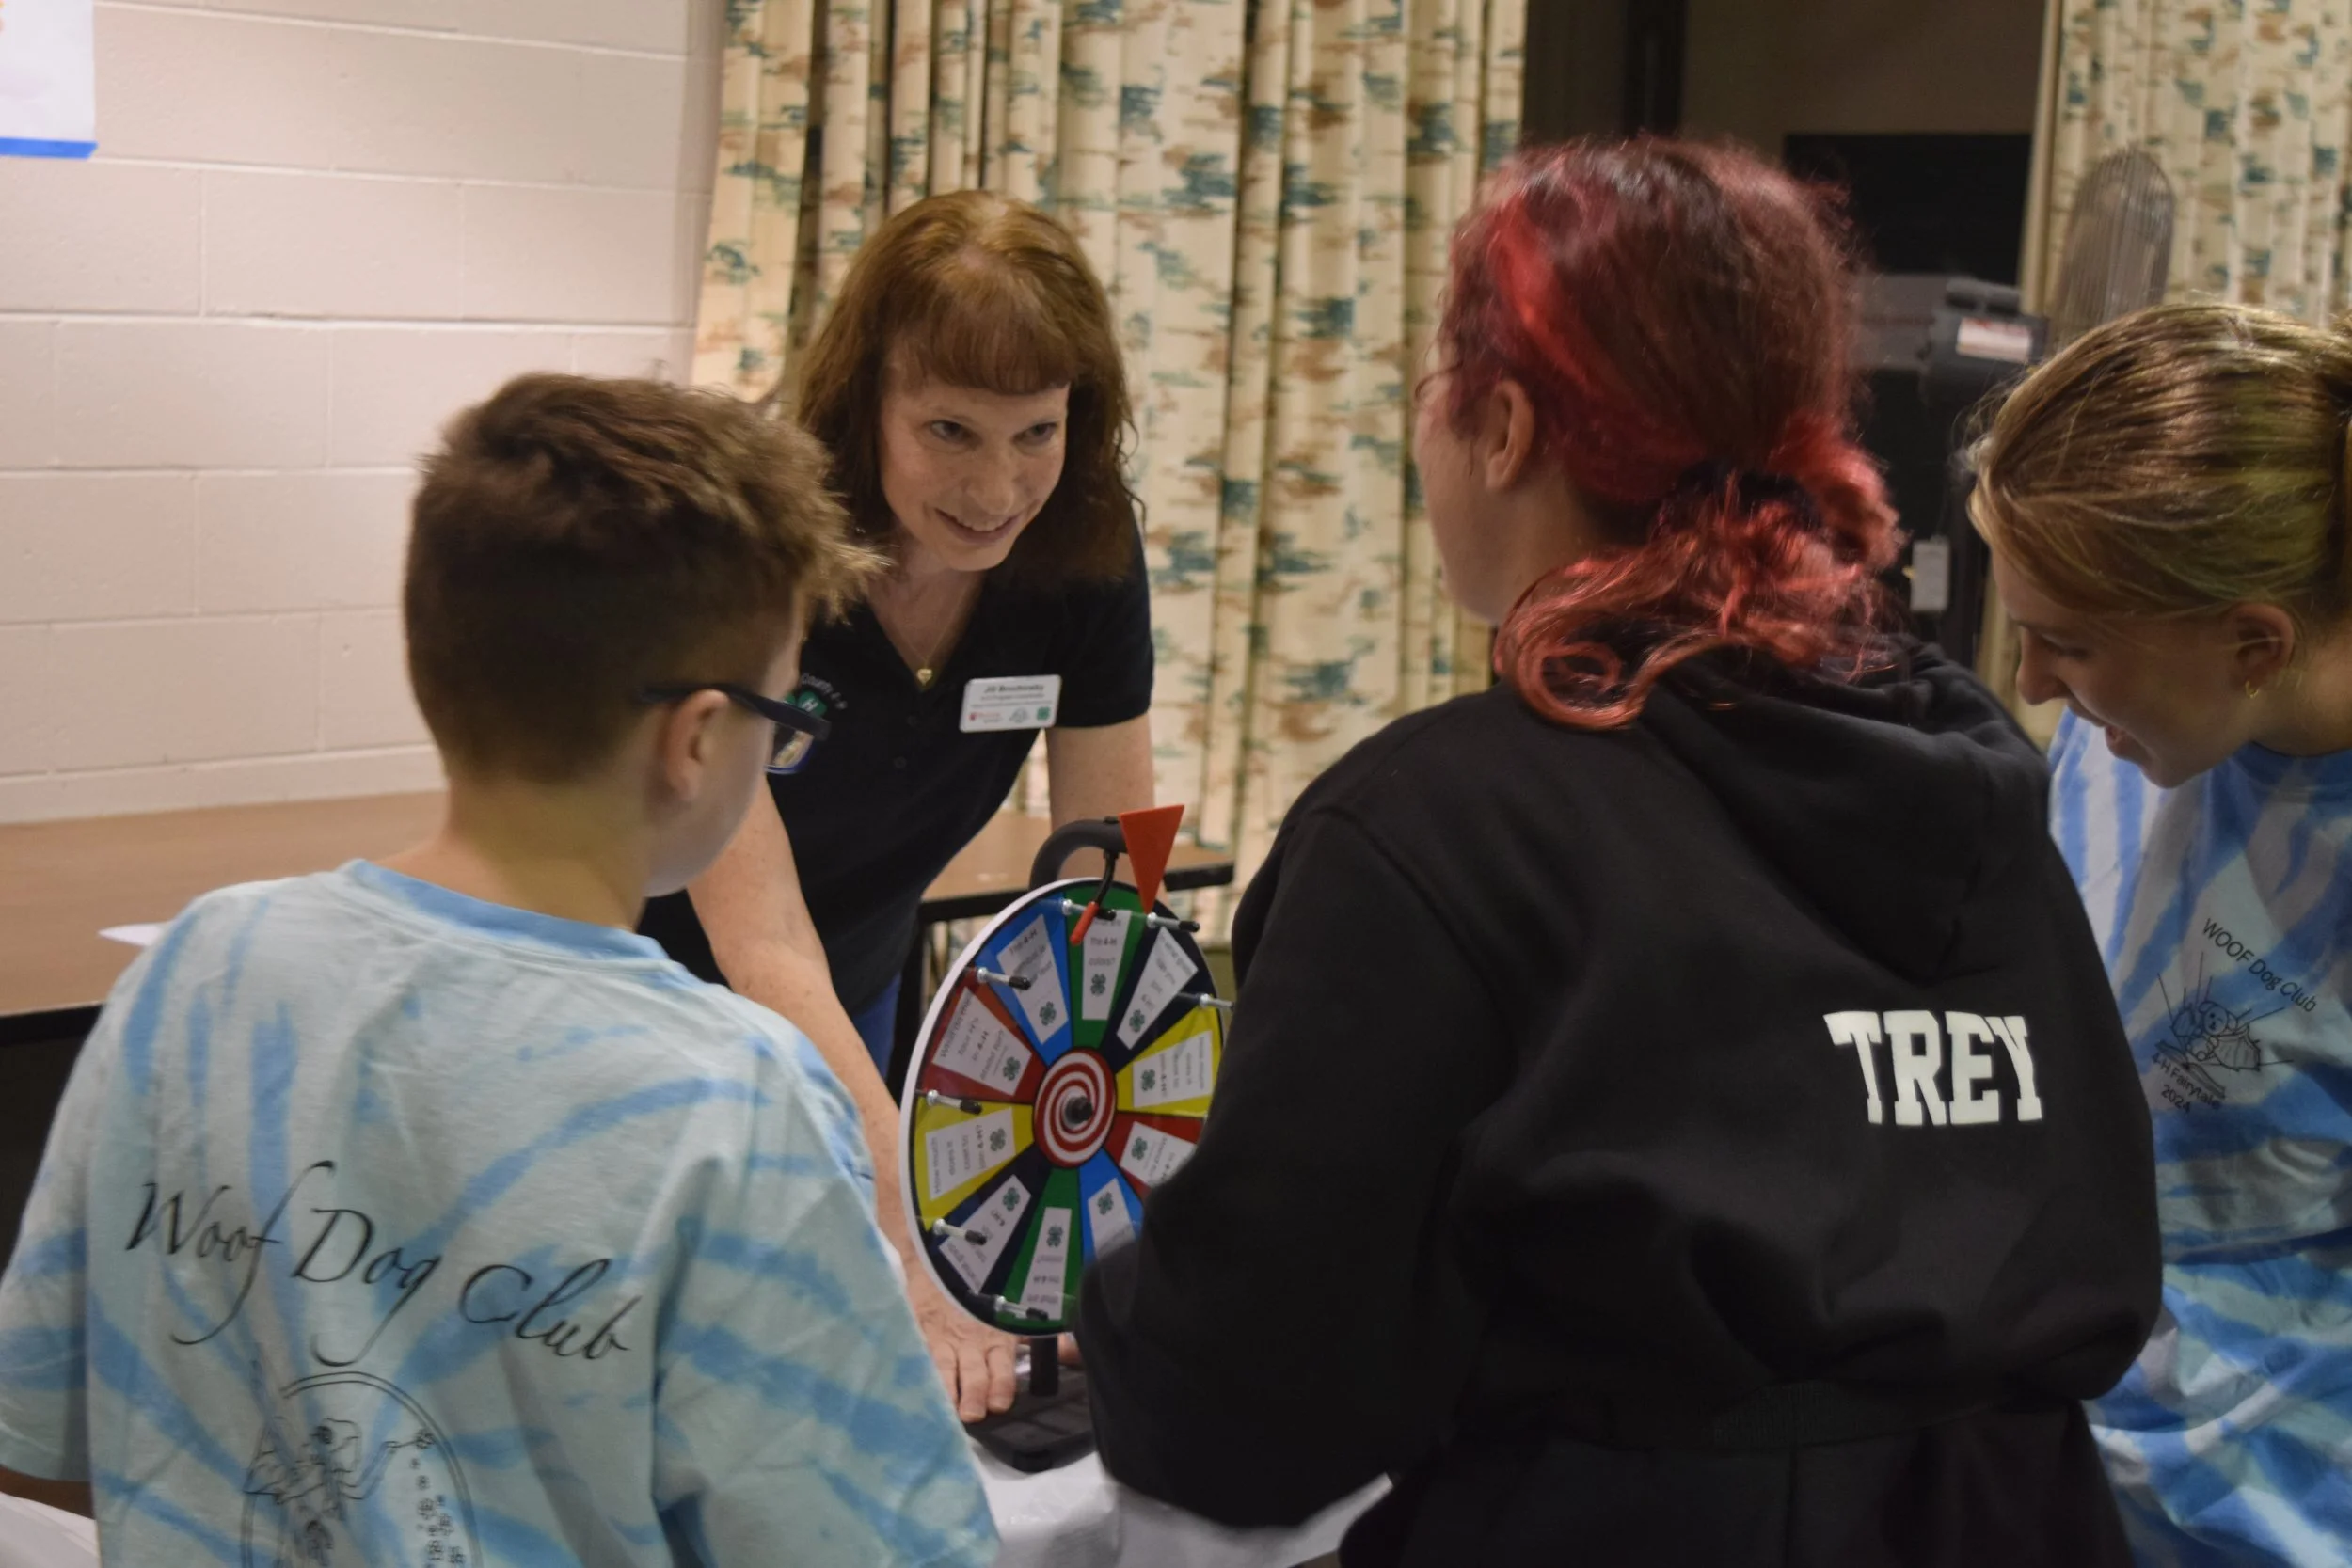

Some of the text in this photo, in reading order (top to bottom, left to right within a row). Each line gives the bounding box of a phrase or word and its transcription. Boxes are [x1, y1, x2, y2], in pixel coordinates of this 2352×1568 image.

[2202, 918, 2317, 1013] WOOF Dog Club
[1822, 1010, 2042, 1126] TREY
[2160, 1084, 2193, 1113] 2024
[126, 1160, 643, 1367] Woof Dog Club
